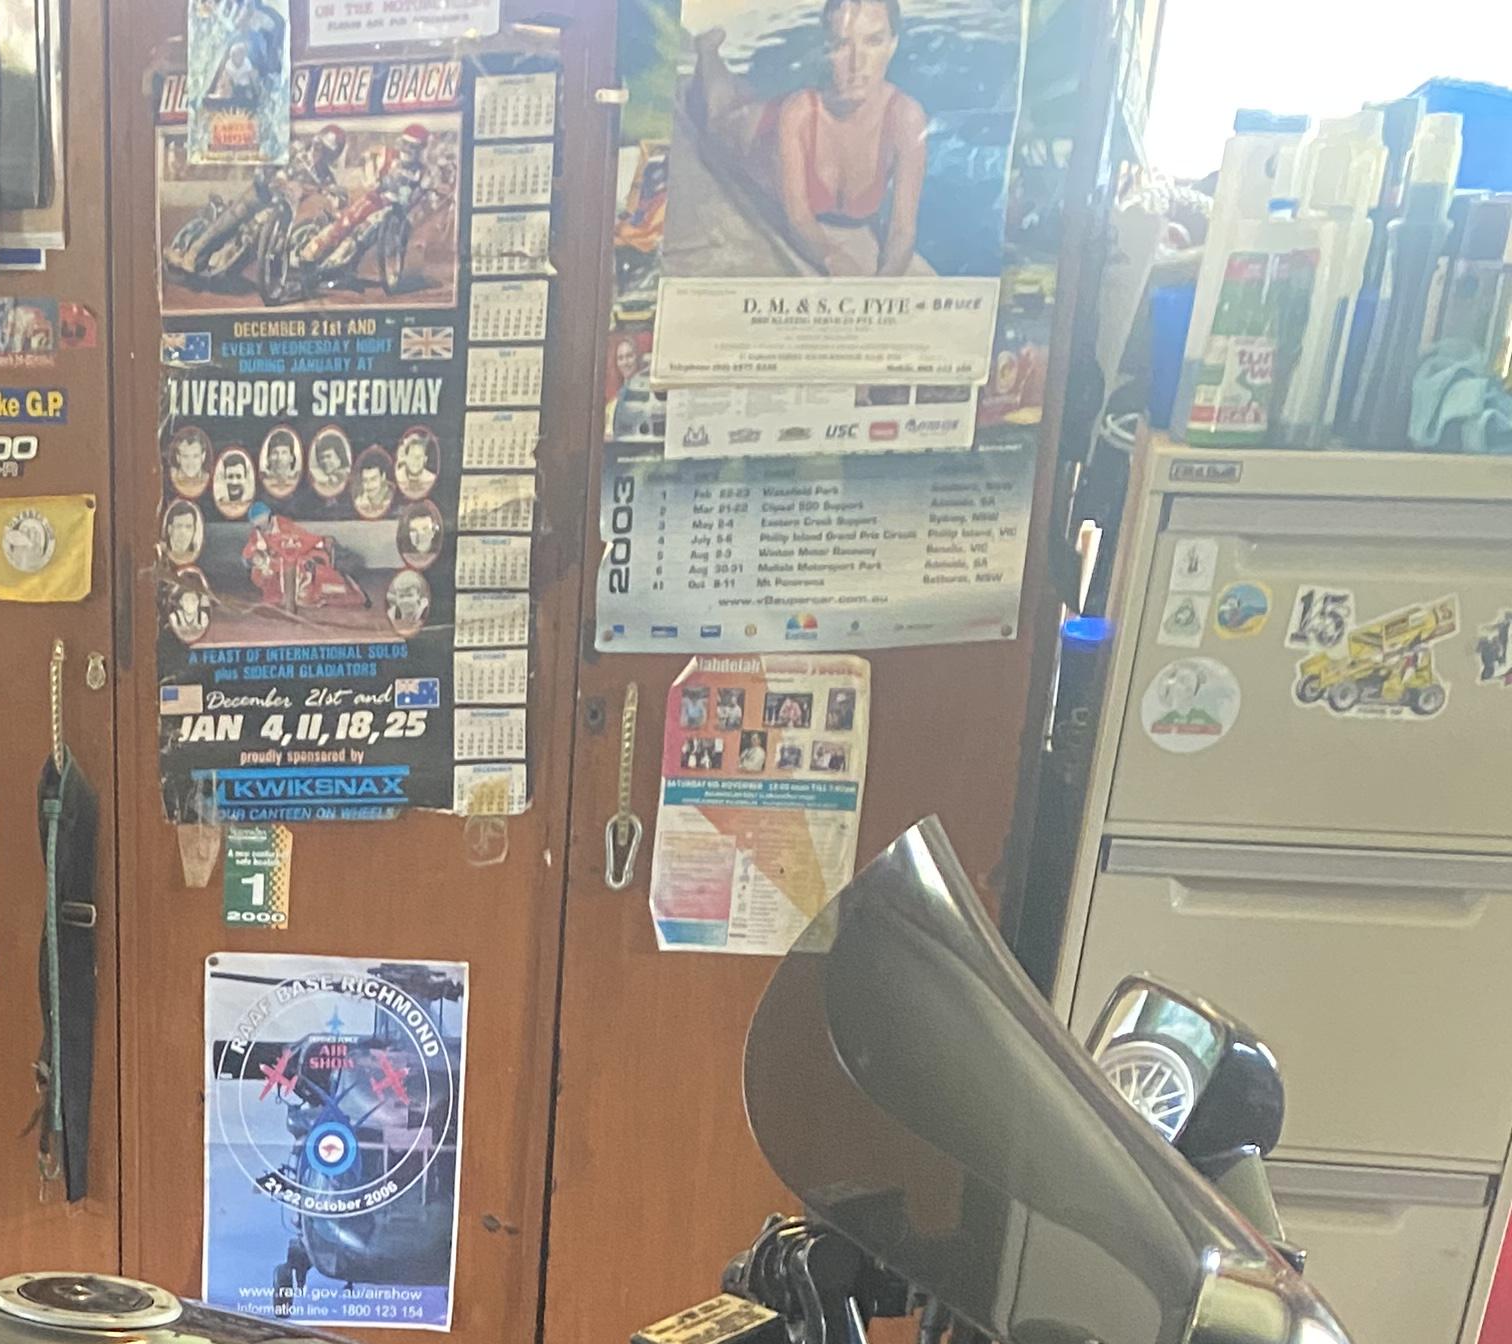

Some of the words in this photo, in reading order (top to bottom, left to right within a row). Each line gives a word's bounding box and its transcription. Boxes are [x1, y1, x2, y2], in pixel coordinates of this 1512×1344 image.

[316, 65, 369, 103] ARE
[387, 62, 460, 100] BACK
[796, 298, 809, 313] &
[816, 298, 831, 314] S.
[839, 298, 856, 314] C.
[234, 320, 305, 338] DECEMBER
[311, 320, 341, 336] 21st
[348, 319, 376, 334] AND
[222, 342, 264, 357] EVERY
[269, 340, 349, 356] WEDNESDAY
[240, 360, 285, 373] DURING
[290, 358, 350, 372] JANUARY
[357, 358, 374, 370] AT
[26, 391, 64, 417] G.P.
[169, 379, 298, 417] LIVERPOOL
[312, 378, 443, 417] SPEEDWAY
[609, 476, 634, 594] 2003
[203, 651, 240, 663] FEAST
[246, 649, 260, 663] OF
[266, 646, 361, 662] INTERNATIONAL
[215, 669, 238, 682] plus
[244, 666, 295, 679] SIDECAR
[299, 662, 377, 678] GLADIATORS
[207, 687, 292, 710] December
[305, 687, 352, 707] 21st
[354, 684, 393, 703] and
[179, 714, 244, 742] JAN
[240, 750, 282, 766] proudly
[287, 749, 345, 764] sponsored
[350, 748, 364, 765] by
[235, 775, 404, 798] KWIKSNAX
[249, 807, 311, 820] CANTEEN
[315, 806, 336, 819] ON
[241, 873, 264, 905] 1
[227, 911, 286, 922] 2000
[229, 1003, 272, 1055] RAAF
[277, 974, 336, 1004] BASE
[341, 974, 440, 1059] RICHMOND
[319, 1044, 347, 1056] AIR
[309, 1056, 355, 1069] SHOW
[304, 1197, 362, 1213] October
[238, 1284, 424, 1301] www.raaf.gov.au/airshow
[237, 1303, 304, 1317] Information
[307, 1303, 328, 1316] line
[342, 1304, 371, 1318] 1800
[375, 1304, 397, 1318] 123
[401, 1306, 424, 1319] 154
